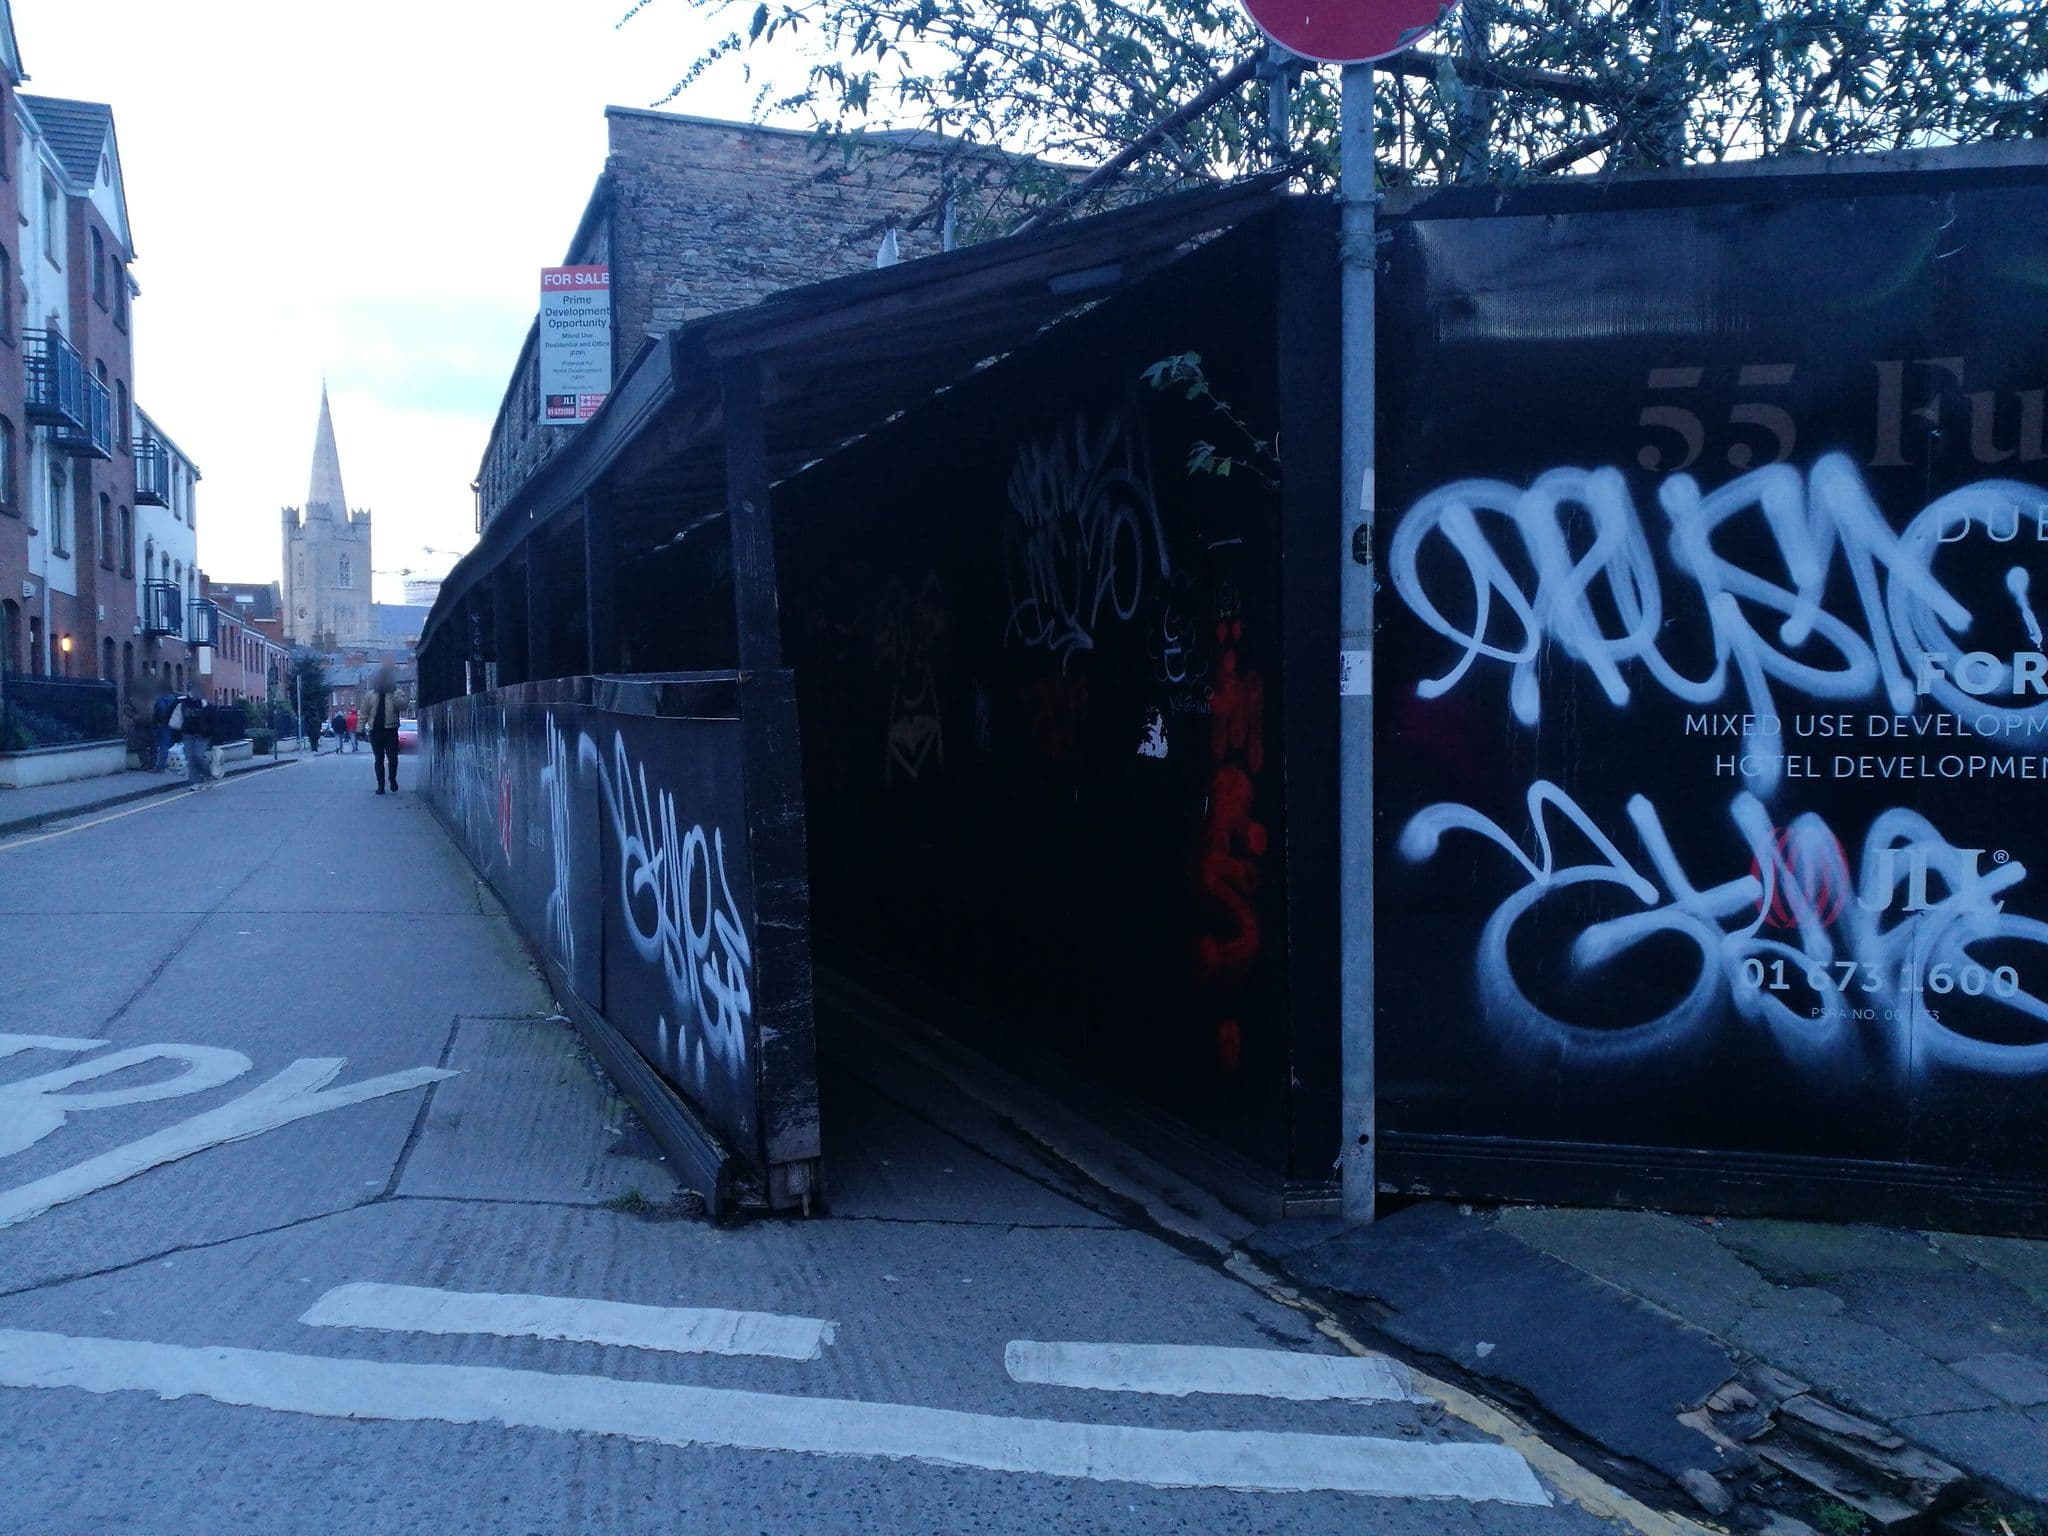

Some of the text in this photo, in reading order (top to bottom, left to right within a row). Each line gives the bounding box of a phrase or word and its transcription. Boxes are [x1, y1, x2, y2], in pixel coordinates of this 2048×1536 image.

[544, 273, 610, 285] FOR SALE
[562, 296, 592, 304] Prime
[545, 307, 610, 317] Development
[548, 319, 607, 329] Opportunity
[1637, 356, 2048, 472] 55 Fu
[1685, 714, 1781, 736] MIXED
[1796, 715, 1854, 737] USE
[1742, 958, 1791, 989] 01
[1900, 963, 2019, 998] 1600
